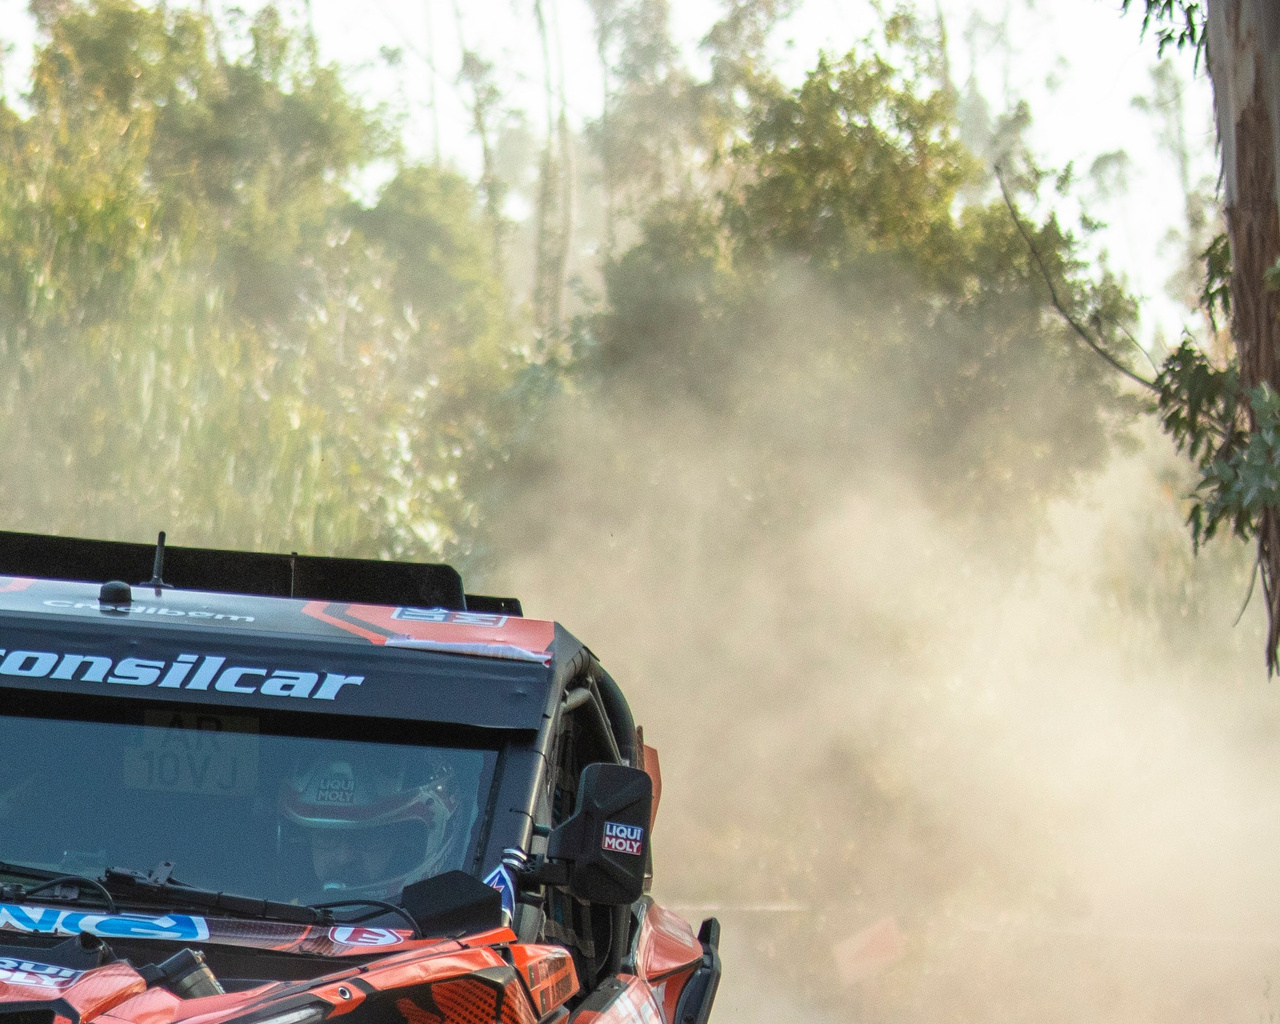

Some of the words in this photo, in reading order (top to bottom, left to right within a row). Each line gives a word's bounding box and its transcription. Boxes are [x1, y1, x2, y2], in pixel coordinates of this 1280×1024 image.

[318, 790, 354, 802] MOLY
[605, 823, 642, 841] LIQUI
[604, 837, 642, 853] MOLY
